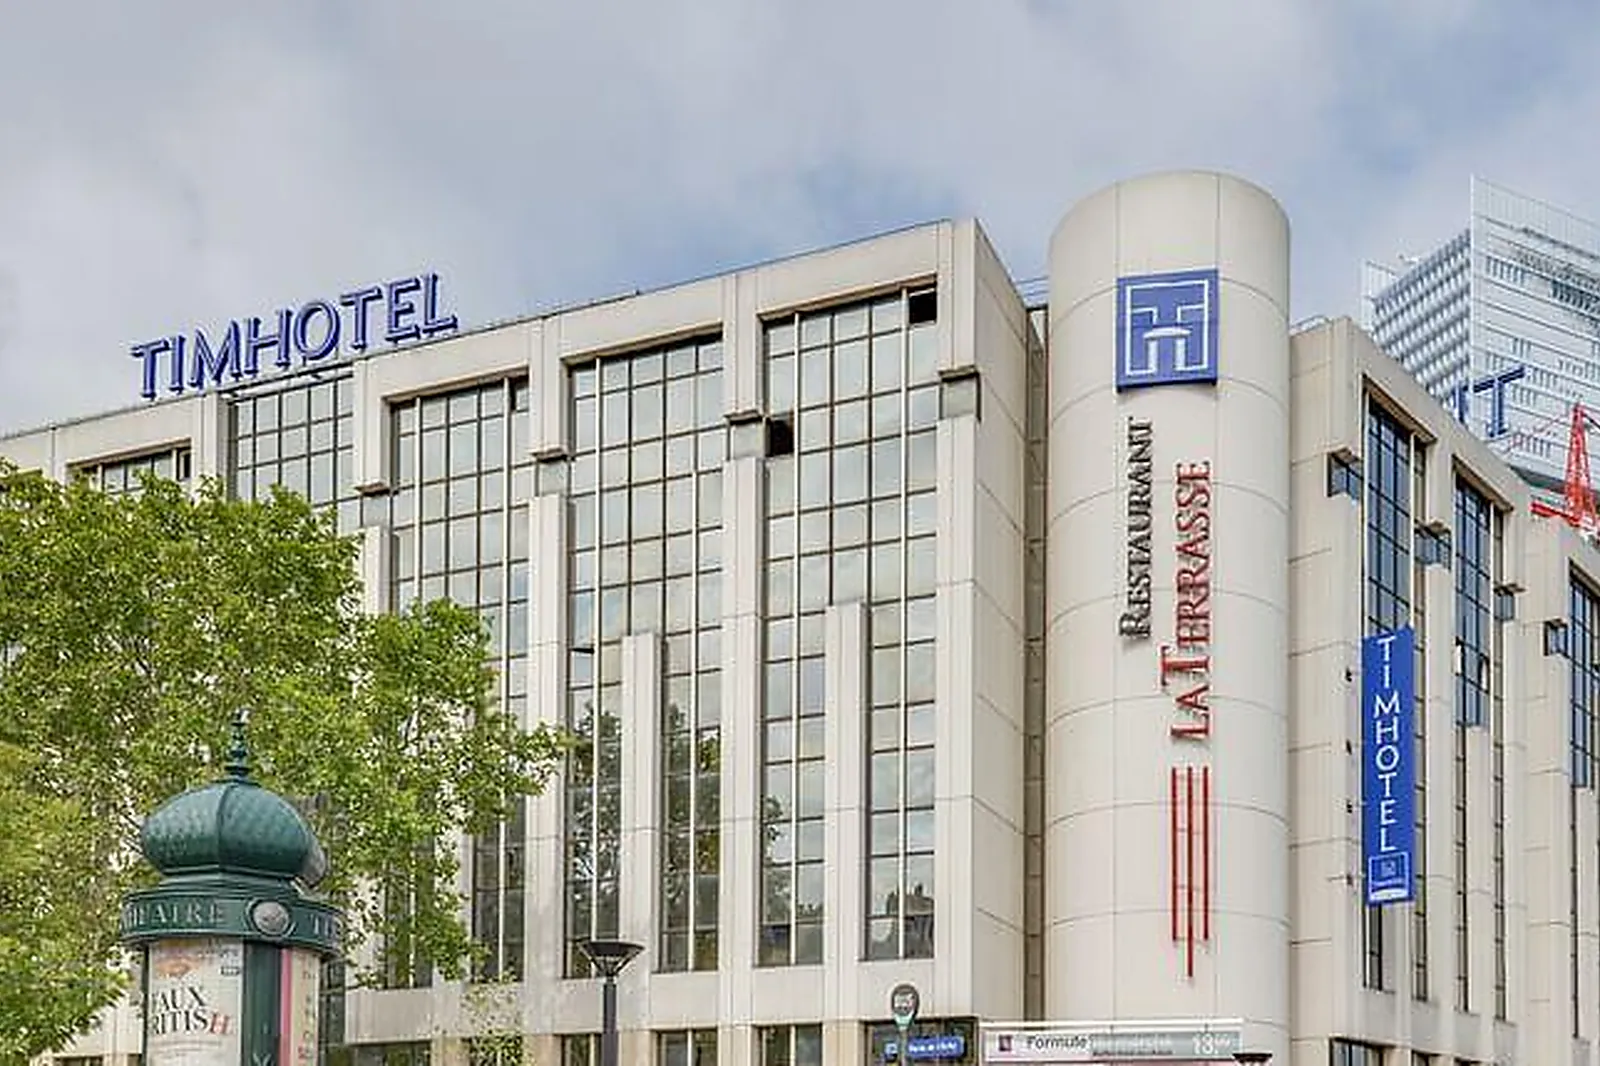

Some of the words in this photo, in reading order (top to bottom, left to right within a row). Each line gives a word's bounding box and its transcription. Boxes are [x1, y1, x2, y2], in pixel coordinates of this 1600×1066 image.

[131, 272, 458, 398] TIMHOTEL
[1119, 416, 1151, 640] RESTAURANT
[1161, 461, 1210, 687] TERRASSE
[1171, 686, 1210, 741] LA
[1373, 635, 1400, 852] TIMHOTEL
[1027, 1034, 1088, 1049] Formule
